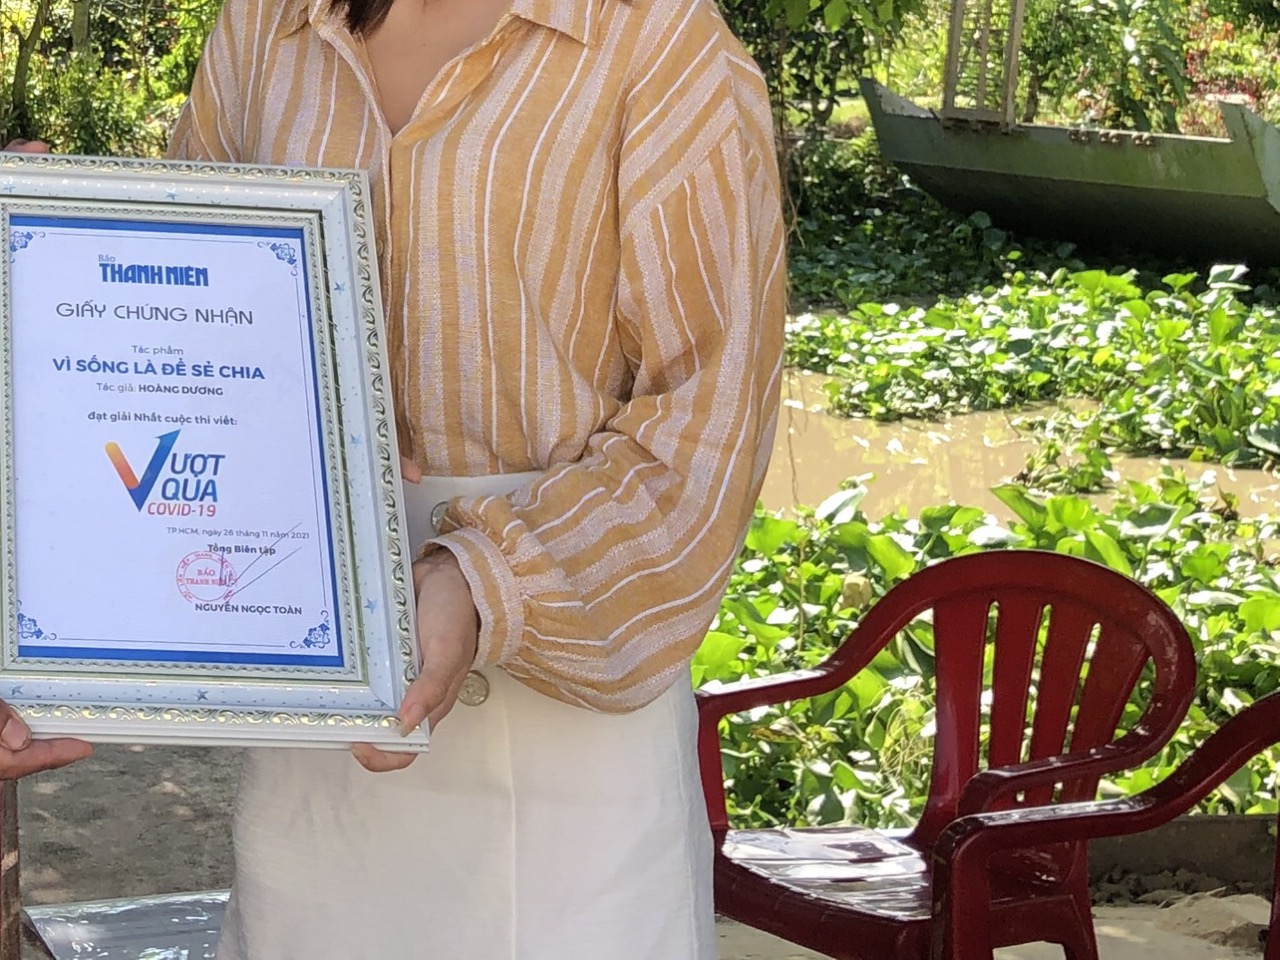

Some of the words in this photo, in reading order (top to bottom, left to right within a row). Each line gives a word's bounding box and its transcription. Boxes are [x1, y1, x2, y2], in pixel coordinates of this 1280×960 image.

[98, 254, 116, 263] Báo
[99, 263, 164, 285] THANH
[165, 265, 209, 287] NIÊN
[56, 299, 107, 318] GIẤY
[114, 303, 188, 322] CHỨNG
[195, 307, 253, 327] NHẬN
[132, 345, 150, 354] Tác
[52, 356, 71, 371] VÌ
[76, 354, 129, 374] SỐNG
[134, 359, 158, 375] LÀ
[161, 358, 187, 376] ĐỂ
[191, 361, 215, 378] SẺ
[219, 365, 266, 380] CHIA
[96, 382, 115, 392] Tác
[138, 383, 180, 394] HOÀNG
[182, 385, 224, 396] DƯƠNG
[87, 411, 107, 422] đạt
[110, 411, 131, 422] giải
[134, 412, 162, 423] Nhất
[164, 414, 193, 426] cuộc
[194, 415, 210, 425] thi
[213, 415, 238, 426] viết:
[161, 477, 218, 503] QUA
[147, 502, 216, 517] COVID-19
[202, 528, 222, 537] ngày
[236, 529, 260, 539] tháng
[291, 531, 310, 539] 2021
[234, 545, 257, 554] Biên
[197, 567, 216, 577] BÁO
[195, 600, 239, 613] NGUYỄN
[241, 604, 271, 615] NGỌC
[273, 604, 302, 615] TOÀN
